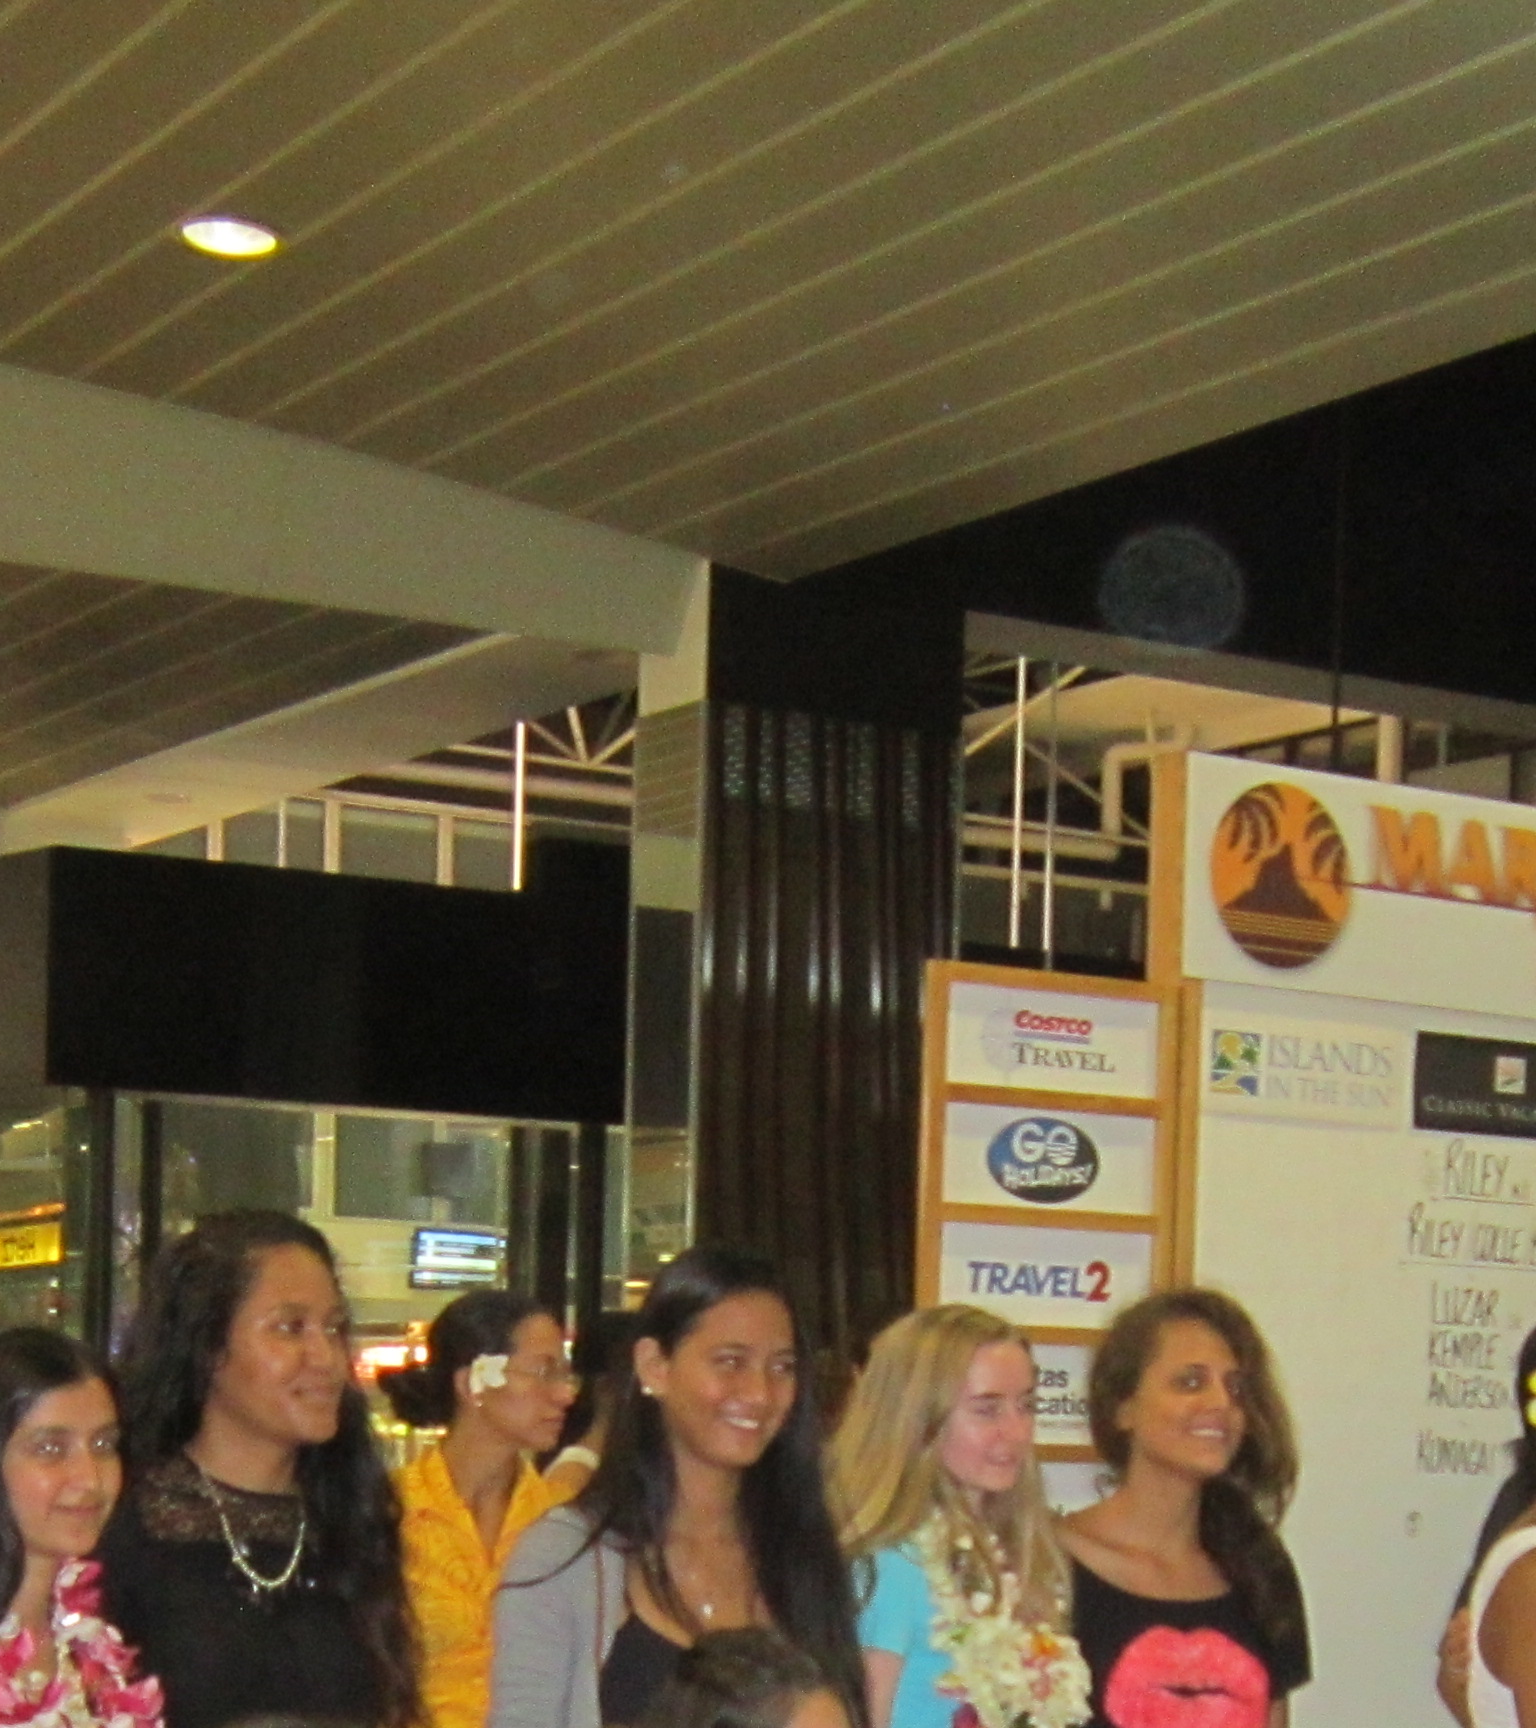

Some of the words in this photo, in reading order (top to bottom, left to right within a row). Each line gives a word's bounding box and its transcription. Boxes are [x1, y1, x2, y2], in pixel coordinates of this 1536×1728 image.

[1013, 1042, 1117, 1073] TRAVEL
[1268, 1033, 1393, 1077] ISLANDS
[1011, 1120, 1079, 1167] GO
[968, 1260, 1113, 1303] TRAVEL2
[1427, 1371, 1516, 1410] ANDERSO
